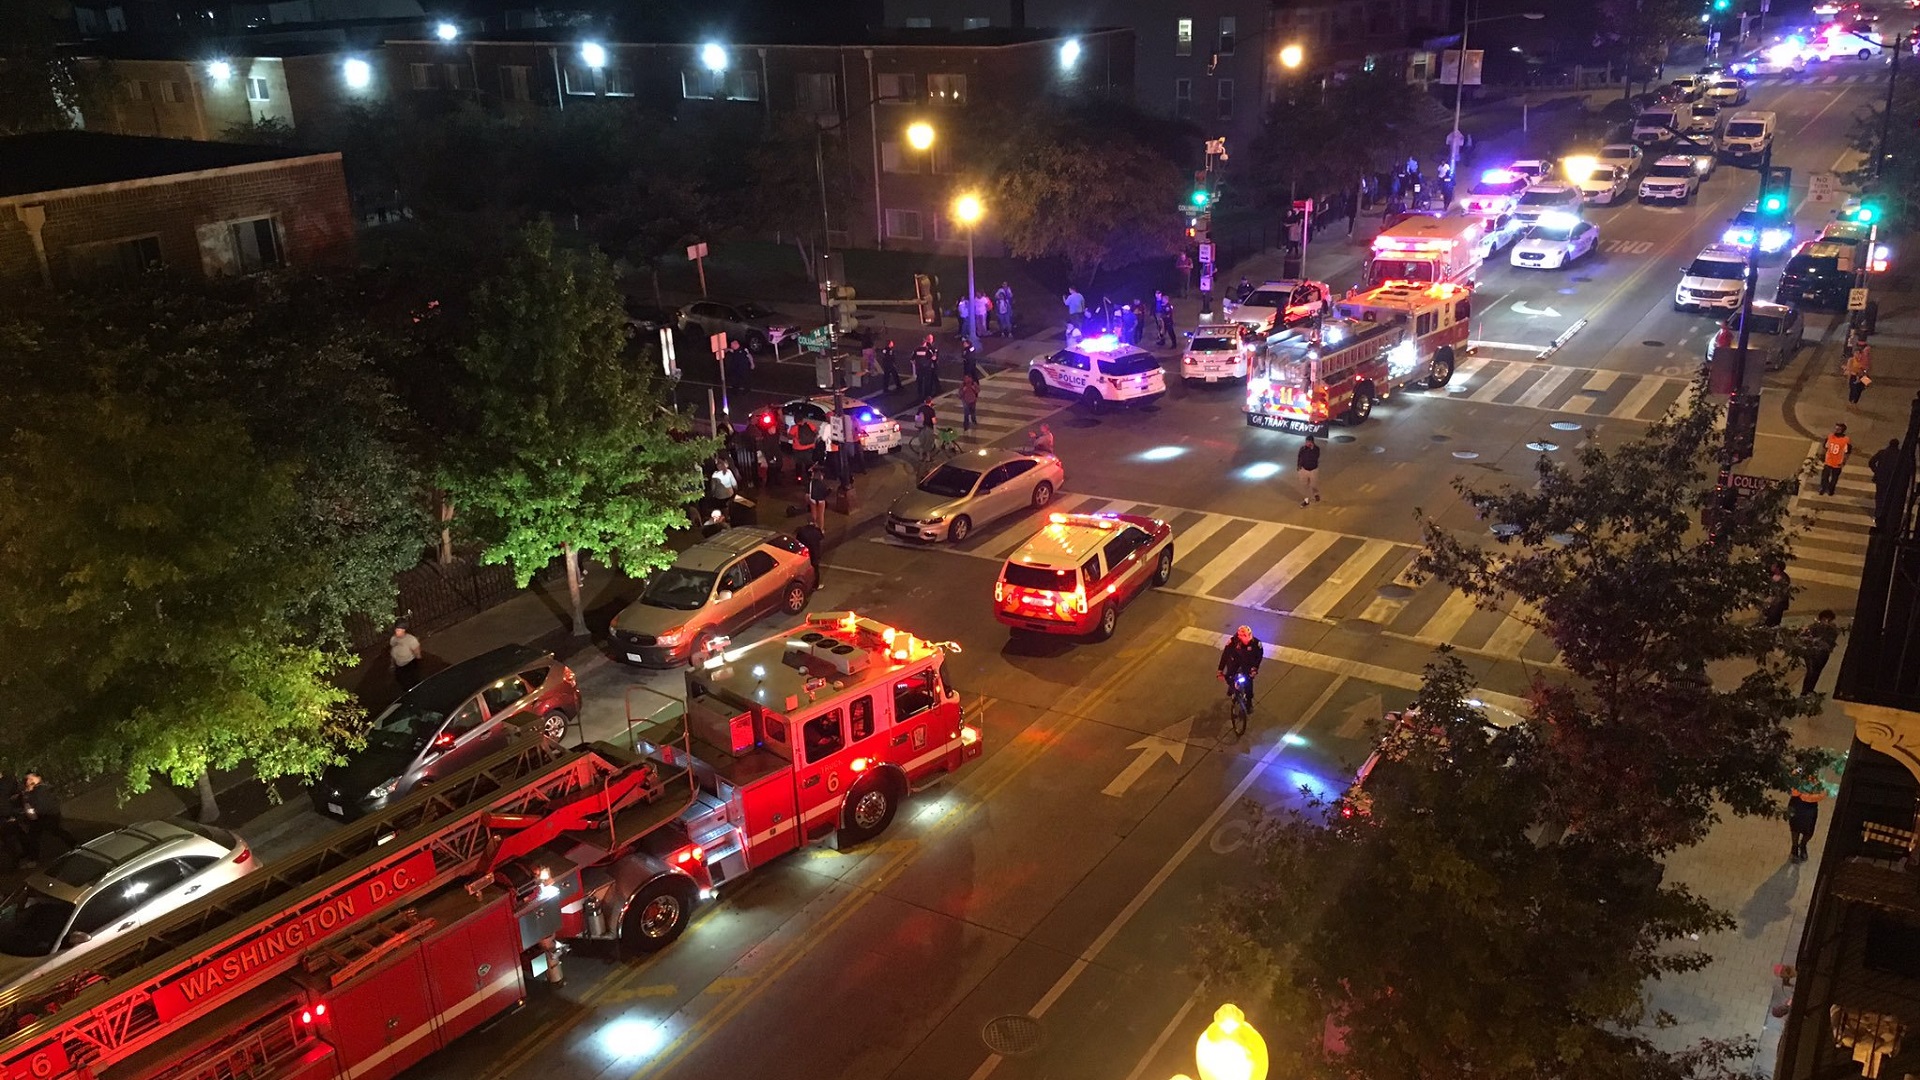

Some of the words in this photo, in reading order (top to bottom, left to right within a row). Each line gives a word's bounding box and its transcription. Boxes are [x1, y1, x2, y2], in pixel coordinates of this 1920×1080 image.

[1058, 373, 1087, 386] POLICE
[1280, 386, 1293, 405] 11
[1830, 443, 1840, 455] 18
[827, 771, 839, 792] 6
[180, 896, 356, 1002] WASHINGTON
[369, 868, 416, 903] D.C.
